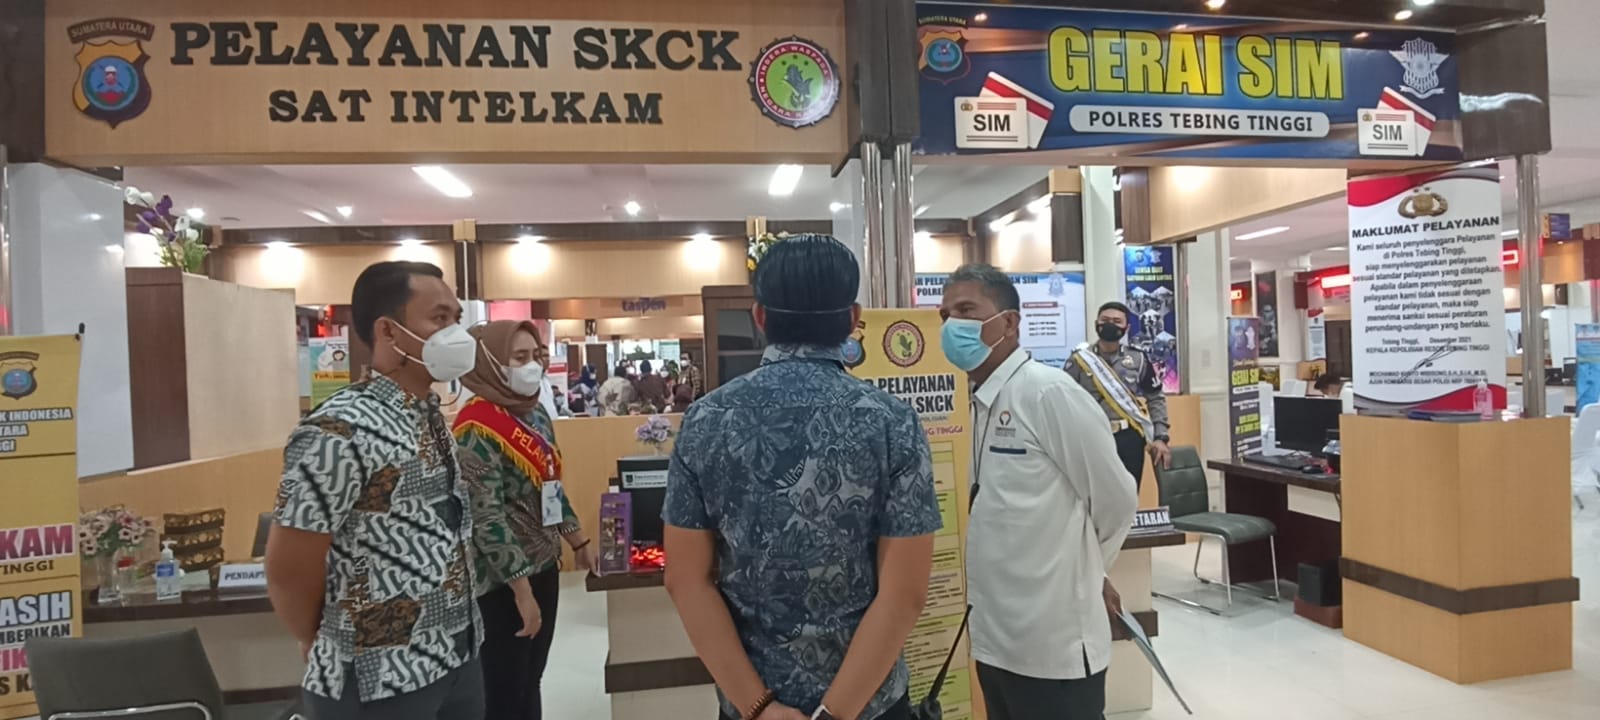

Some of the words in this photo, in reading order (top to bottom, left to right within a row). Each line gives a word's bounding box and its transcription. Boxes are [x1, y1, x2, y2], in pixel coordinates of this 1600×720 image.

[119, 21, 147, 35] UTARA
[170, 21, 553, 69] PELAYANAN
[573, 28, 743, 72] SKCK
[1047, 26, 1224, 96] GERAI
[1237, 34, 1344, 100] SIM
[268, 90, 371, 123] SAT
[390, 91, 664, 126] INTELKAM
[972, 114, 1011, 132] SIM
[1088, 111, 1163, 129] POLRES
[1169, 112, 1240, 131] TEBING
[1246, 114, 1313, 132] TINGGI
[1372, 123, 1403, 142] SIM
[1352, 223, 1418, 238] MAKLUMAT
[1423, 216, 1500, 232] PELAYANAN
[1376, 241, 1401, 249] seluruh
[1403, 237, 1455, 249] penyelenggara
[1457, 233, 1495, 244] Pelayanan
[1391, 251, 1414, 259] Polres
[1416, 248, 1440, 258] Tebing
[1365, 263, 1380, 271] siap
[1382, 259, 1448, 271] menyelenggarakan
[1449, 256, 1487, 266] pelayanan
[1376, 272, 1402, 280] standar
[1403, 270, 1440, 280] pelayanan
[1441, 268, 1459, 278] yang
[1370, 282, 1396, 292] Apabila
[1398, 280, 1419, 289] dalam
[1420, 277, 1483, 289] penyelenggaraan
[1363, 293, 1399, 303] pelayanan
[1400, 291, 1417, 299] kami
[1418, 290, 1436, 298] tidak
[1437, 290, 1460, 298] sesuai
[1462, 288, 1491, 297] dengan
[1374, 303, 1401, 311] standar
[1441, 300, 1461, 308] maka
[1463, 299, 1479, 308] siap
[1426, 311, 1450, 319] sesuai
[1452, 310, 1488, 319] peraturan
[1440, 321, 1459, 331] yang
[878, 374, 956, 394] PELAYANAN
[916, 394, 955, 414] SKCK
[10, 408, 72, 421] INDONESIA
